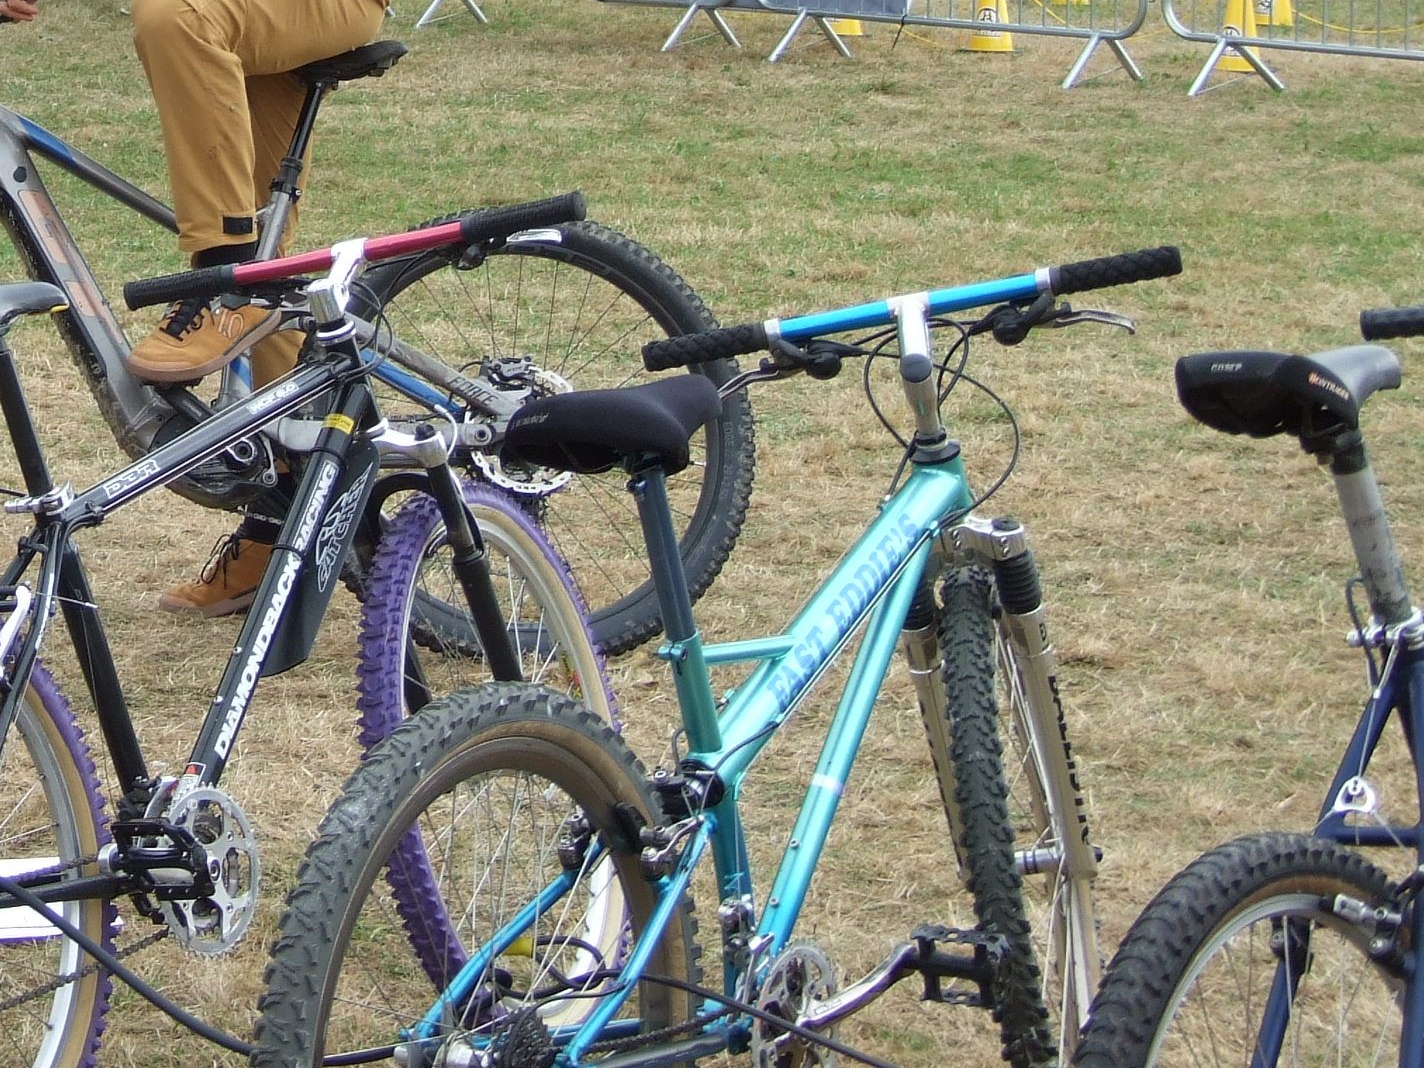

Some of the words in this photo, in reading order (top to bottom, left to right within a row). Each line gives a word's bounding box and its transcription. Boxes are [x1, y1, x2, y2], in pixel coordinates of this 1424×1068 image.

[447, 375, 501, 406] FORCE
[214, 552, 303, 761] DIAMONDBACK
[294, 461, 339, 555] RACING
[767, 625, 825, 712] FAST
